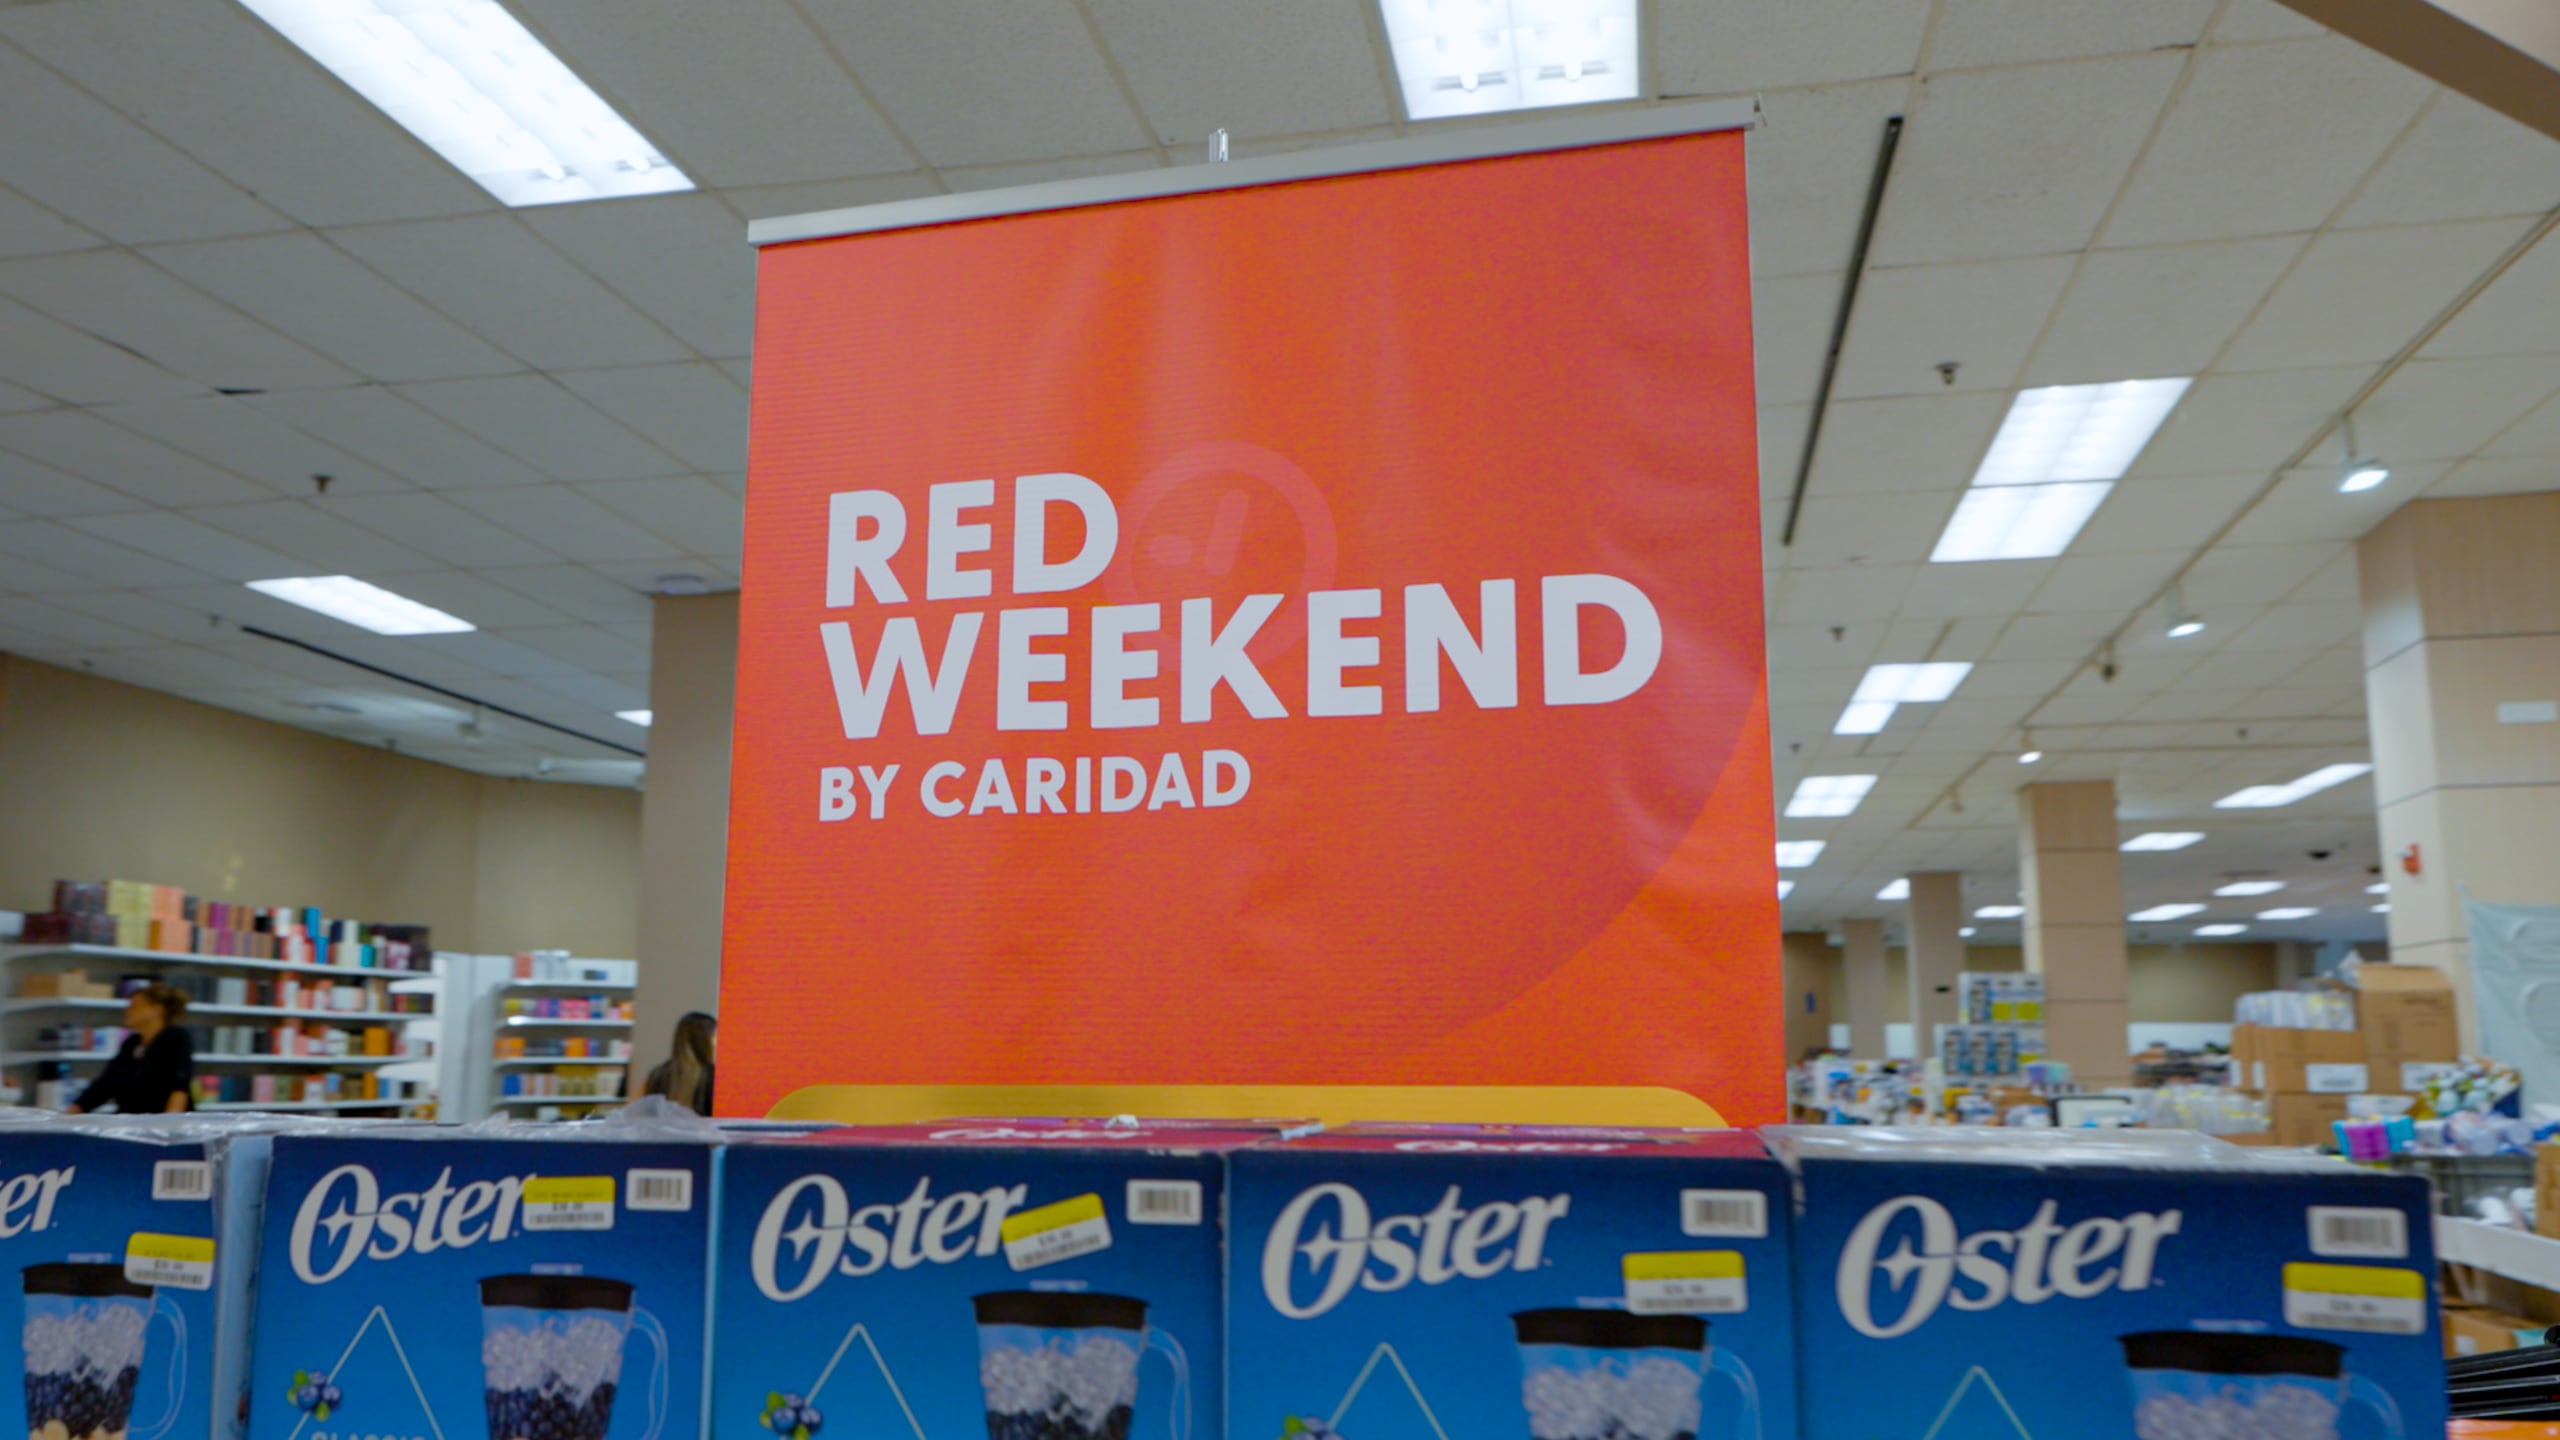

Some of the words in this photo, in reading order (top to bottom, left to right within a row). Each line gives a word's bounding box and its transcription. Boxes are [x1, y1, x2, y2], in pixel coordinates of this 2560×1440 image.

[823, 471, 1121, 610] RED
[818, 572, 1665, 741] WEEKEND
[818, 764, 902, 823] BY
[919, 748, 1253, 818] CARIDAD
[290, 1164, 539, 1285] Oster
[751, 1174, 1028, 1302] Oster
[1262, 1182, 1571, 1320] Oster
[1837, 1195, 2183, 1339] Oster
